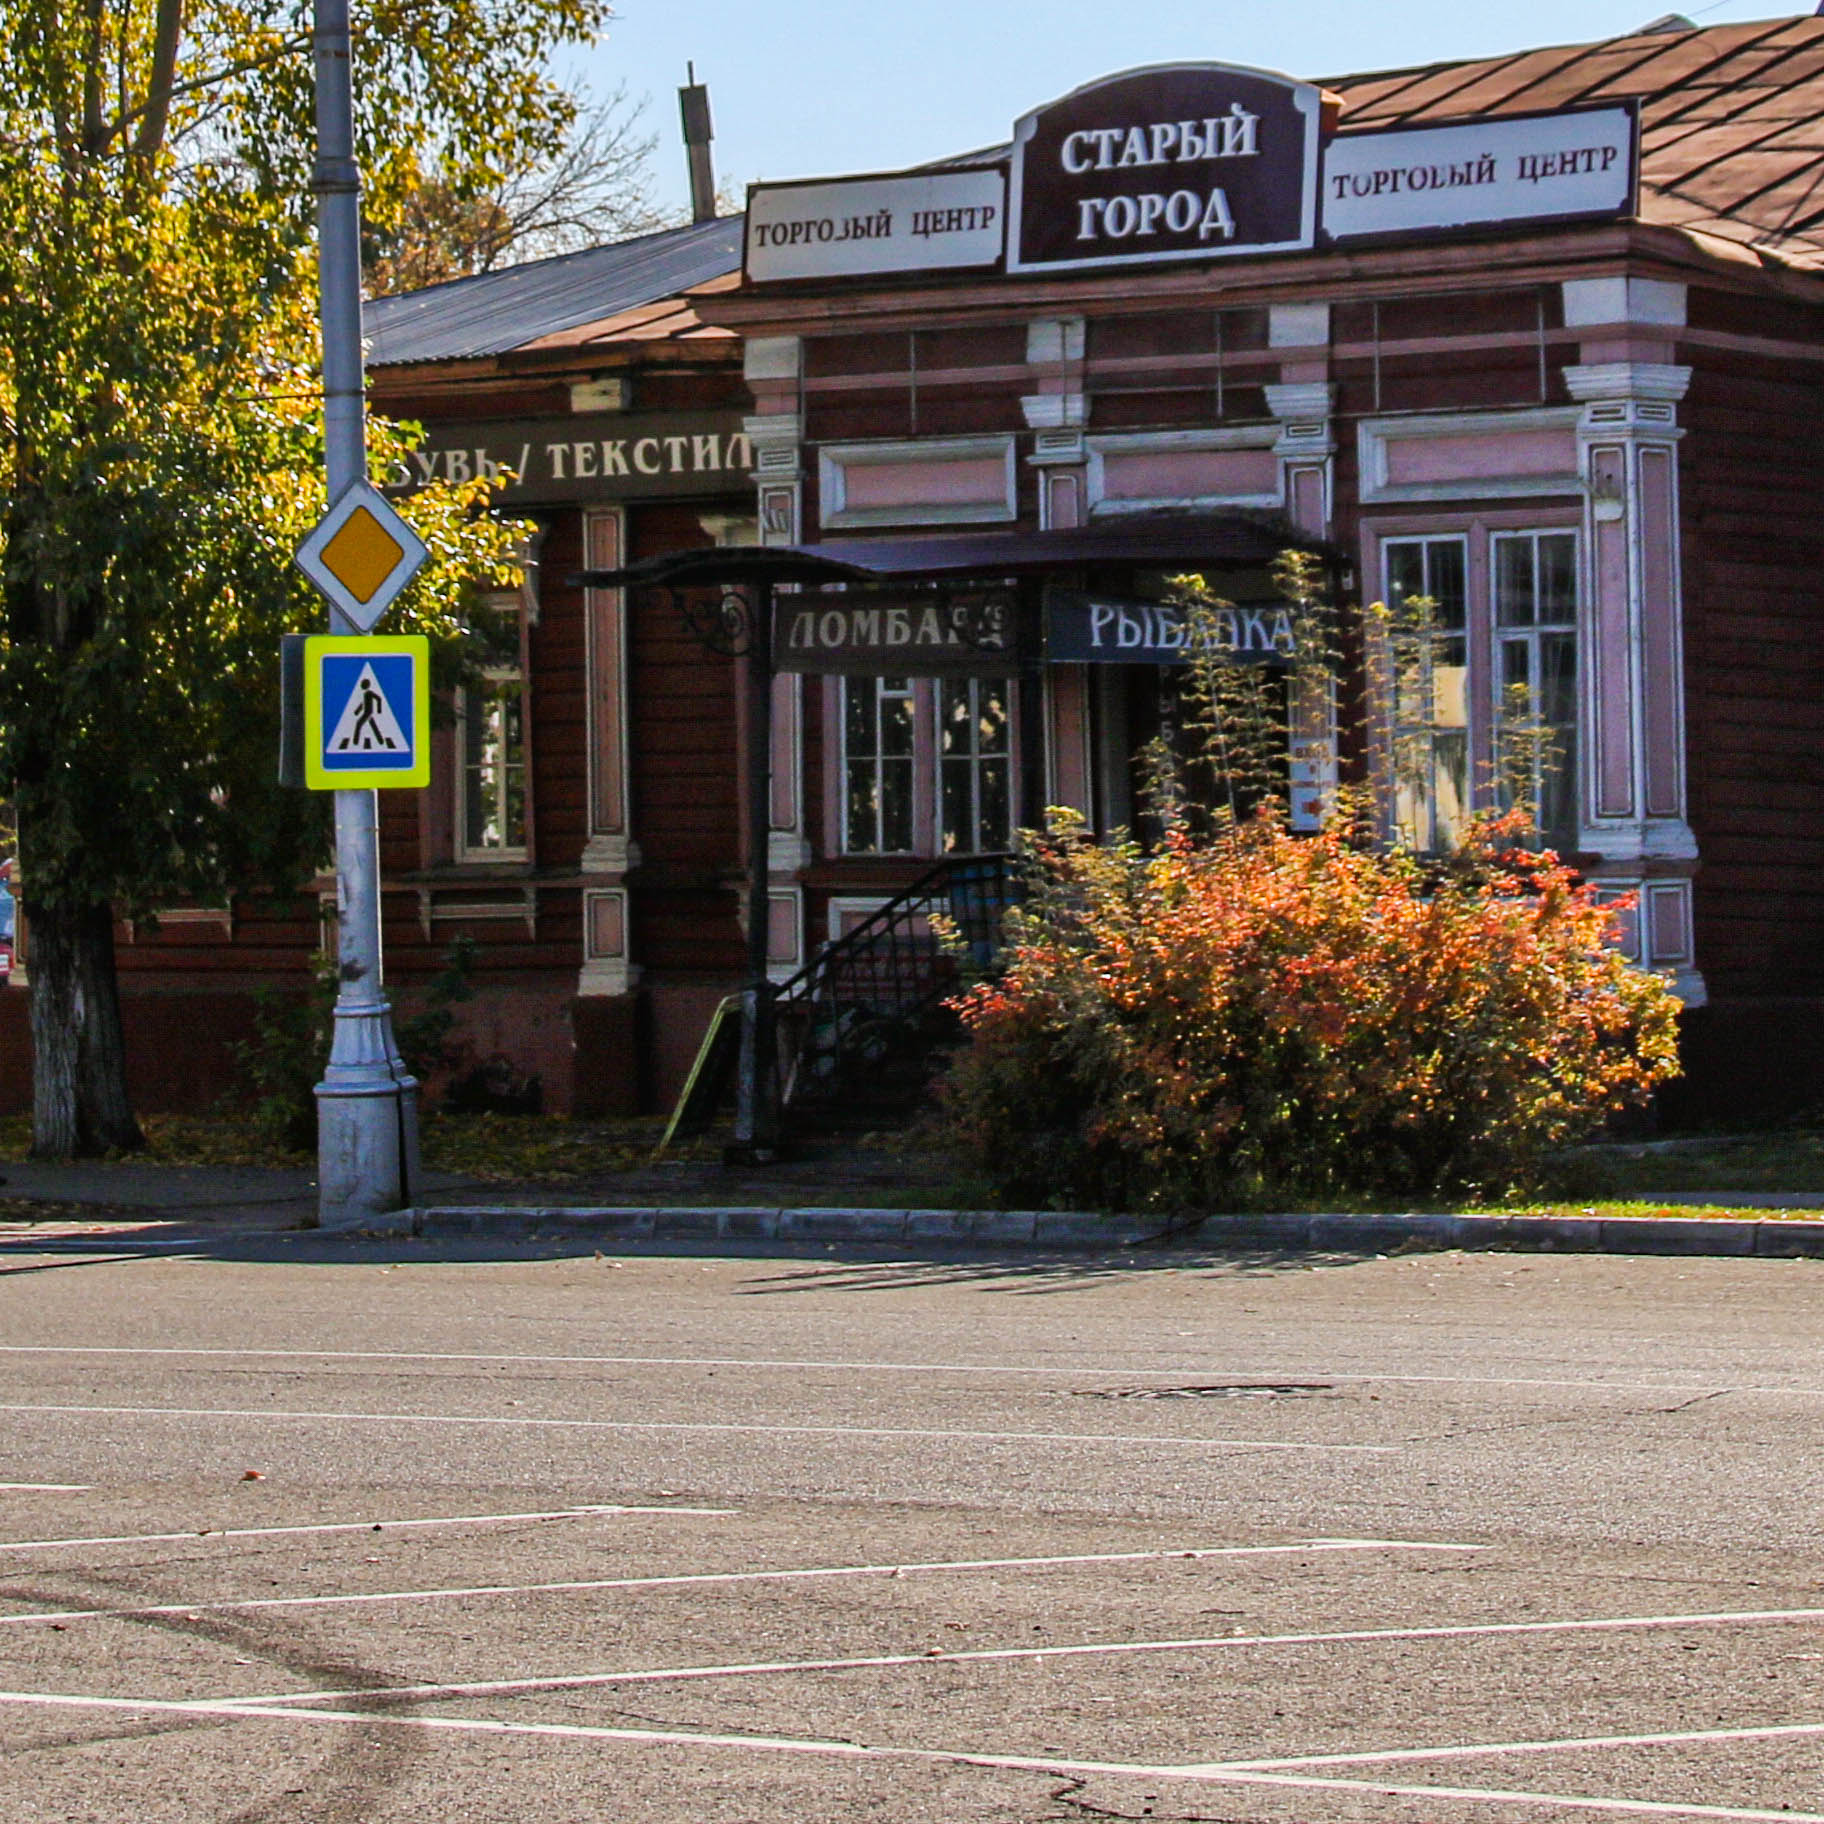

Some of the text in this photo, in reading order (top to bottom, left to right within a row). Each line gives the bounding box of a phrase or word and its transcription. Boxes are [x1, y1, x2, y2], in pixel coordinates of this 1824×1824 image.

[1061, 102, 1261, 175] СТАРЫЙ
[1517, 145, 1619, 184] ЦЕНТР
[911, 205, 996, 239] ЦЕНТР
[1076, 187, 1236, 241] ГОРОД
